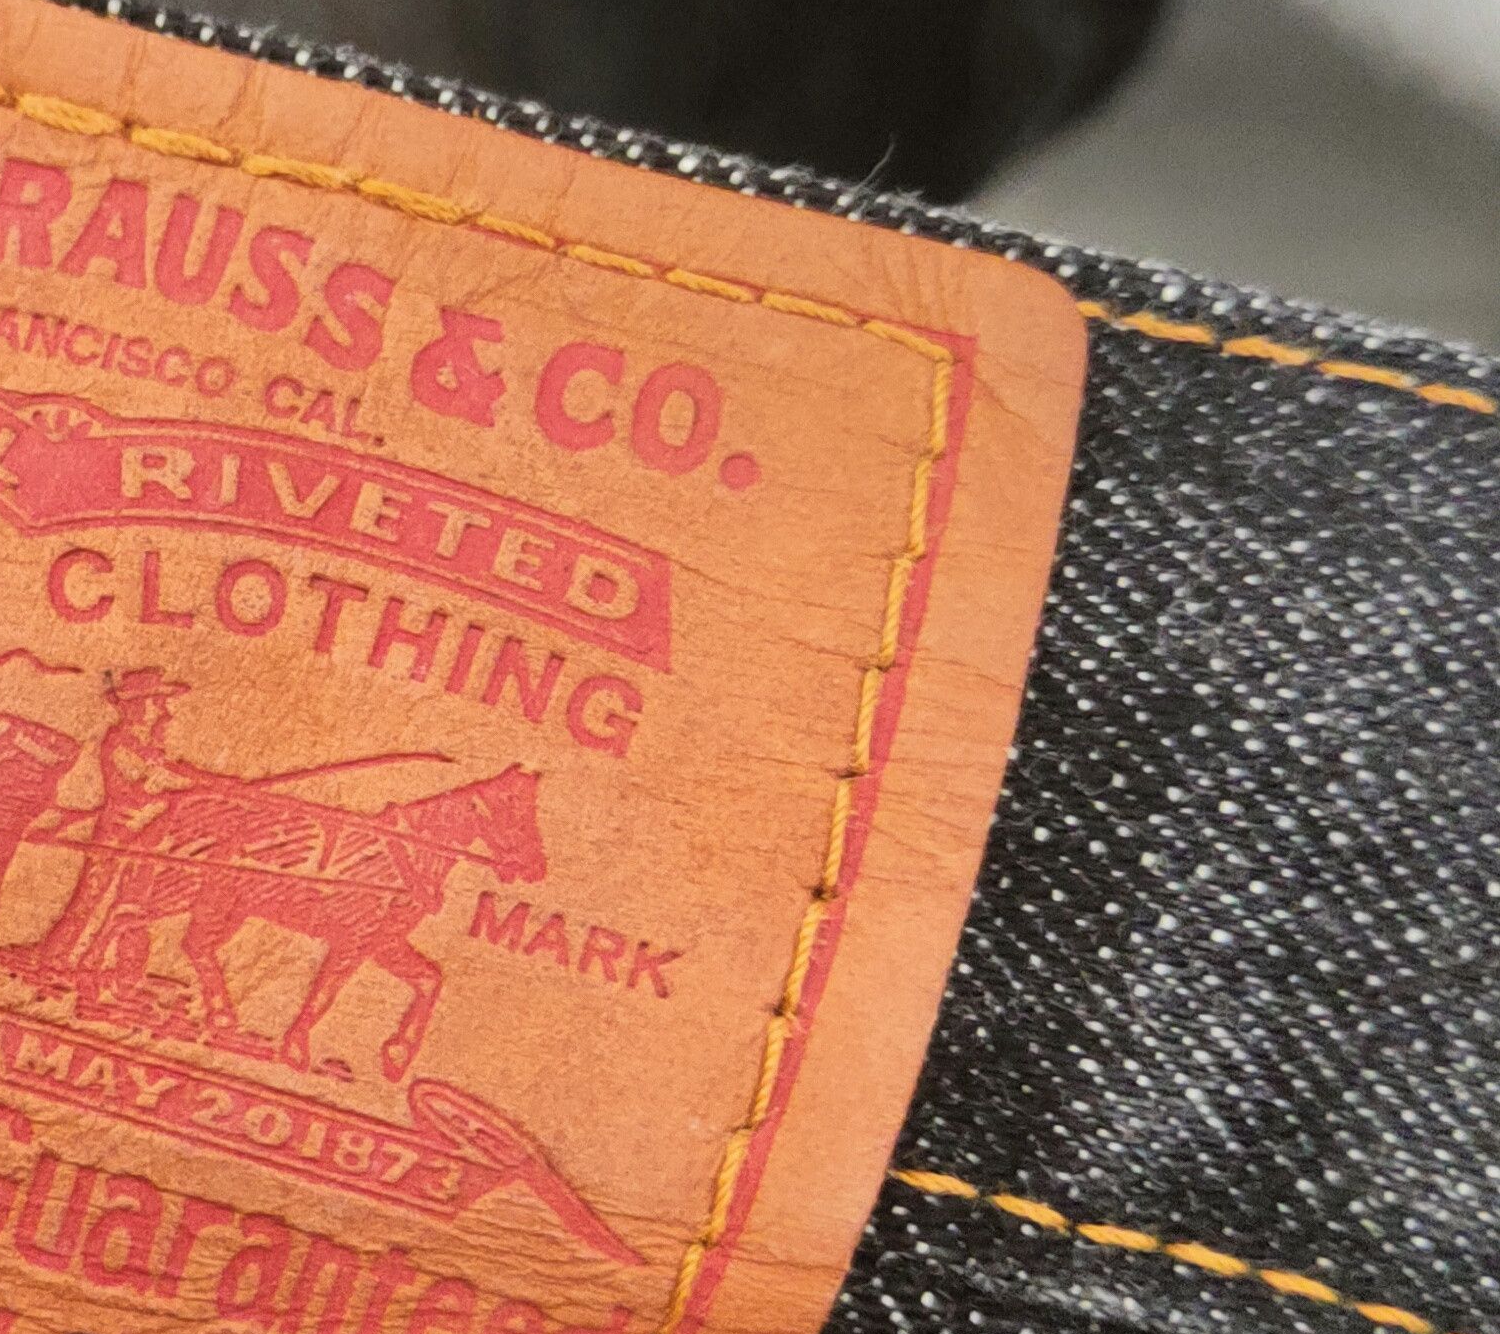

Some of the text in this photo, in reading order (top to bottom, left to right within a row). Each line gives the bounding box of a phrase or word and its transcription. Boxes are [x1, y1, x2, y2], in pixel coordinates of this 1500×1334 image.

[262, 373, 387, 448] CAL.
[408, 305, 507, 428] &
[534, 341, 763, 492] CO.
[119, 444, 641, 621] RIVETED
[48, 547, 644, 759] CLOTHING
[467, 889, 684, 999] MARK
[11, 1031, 180, 1110] MAY
